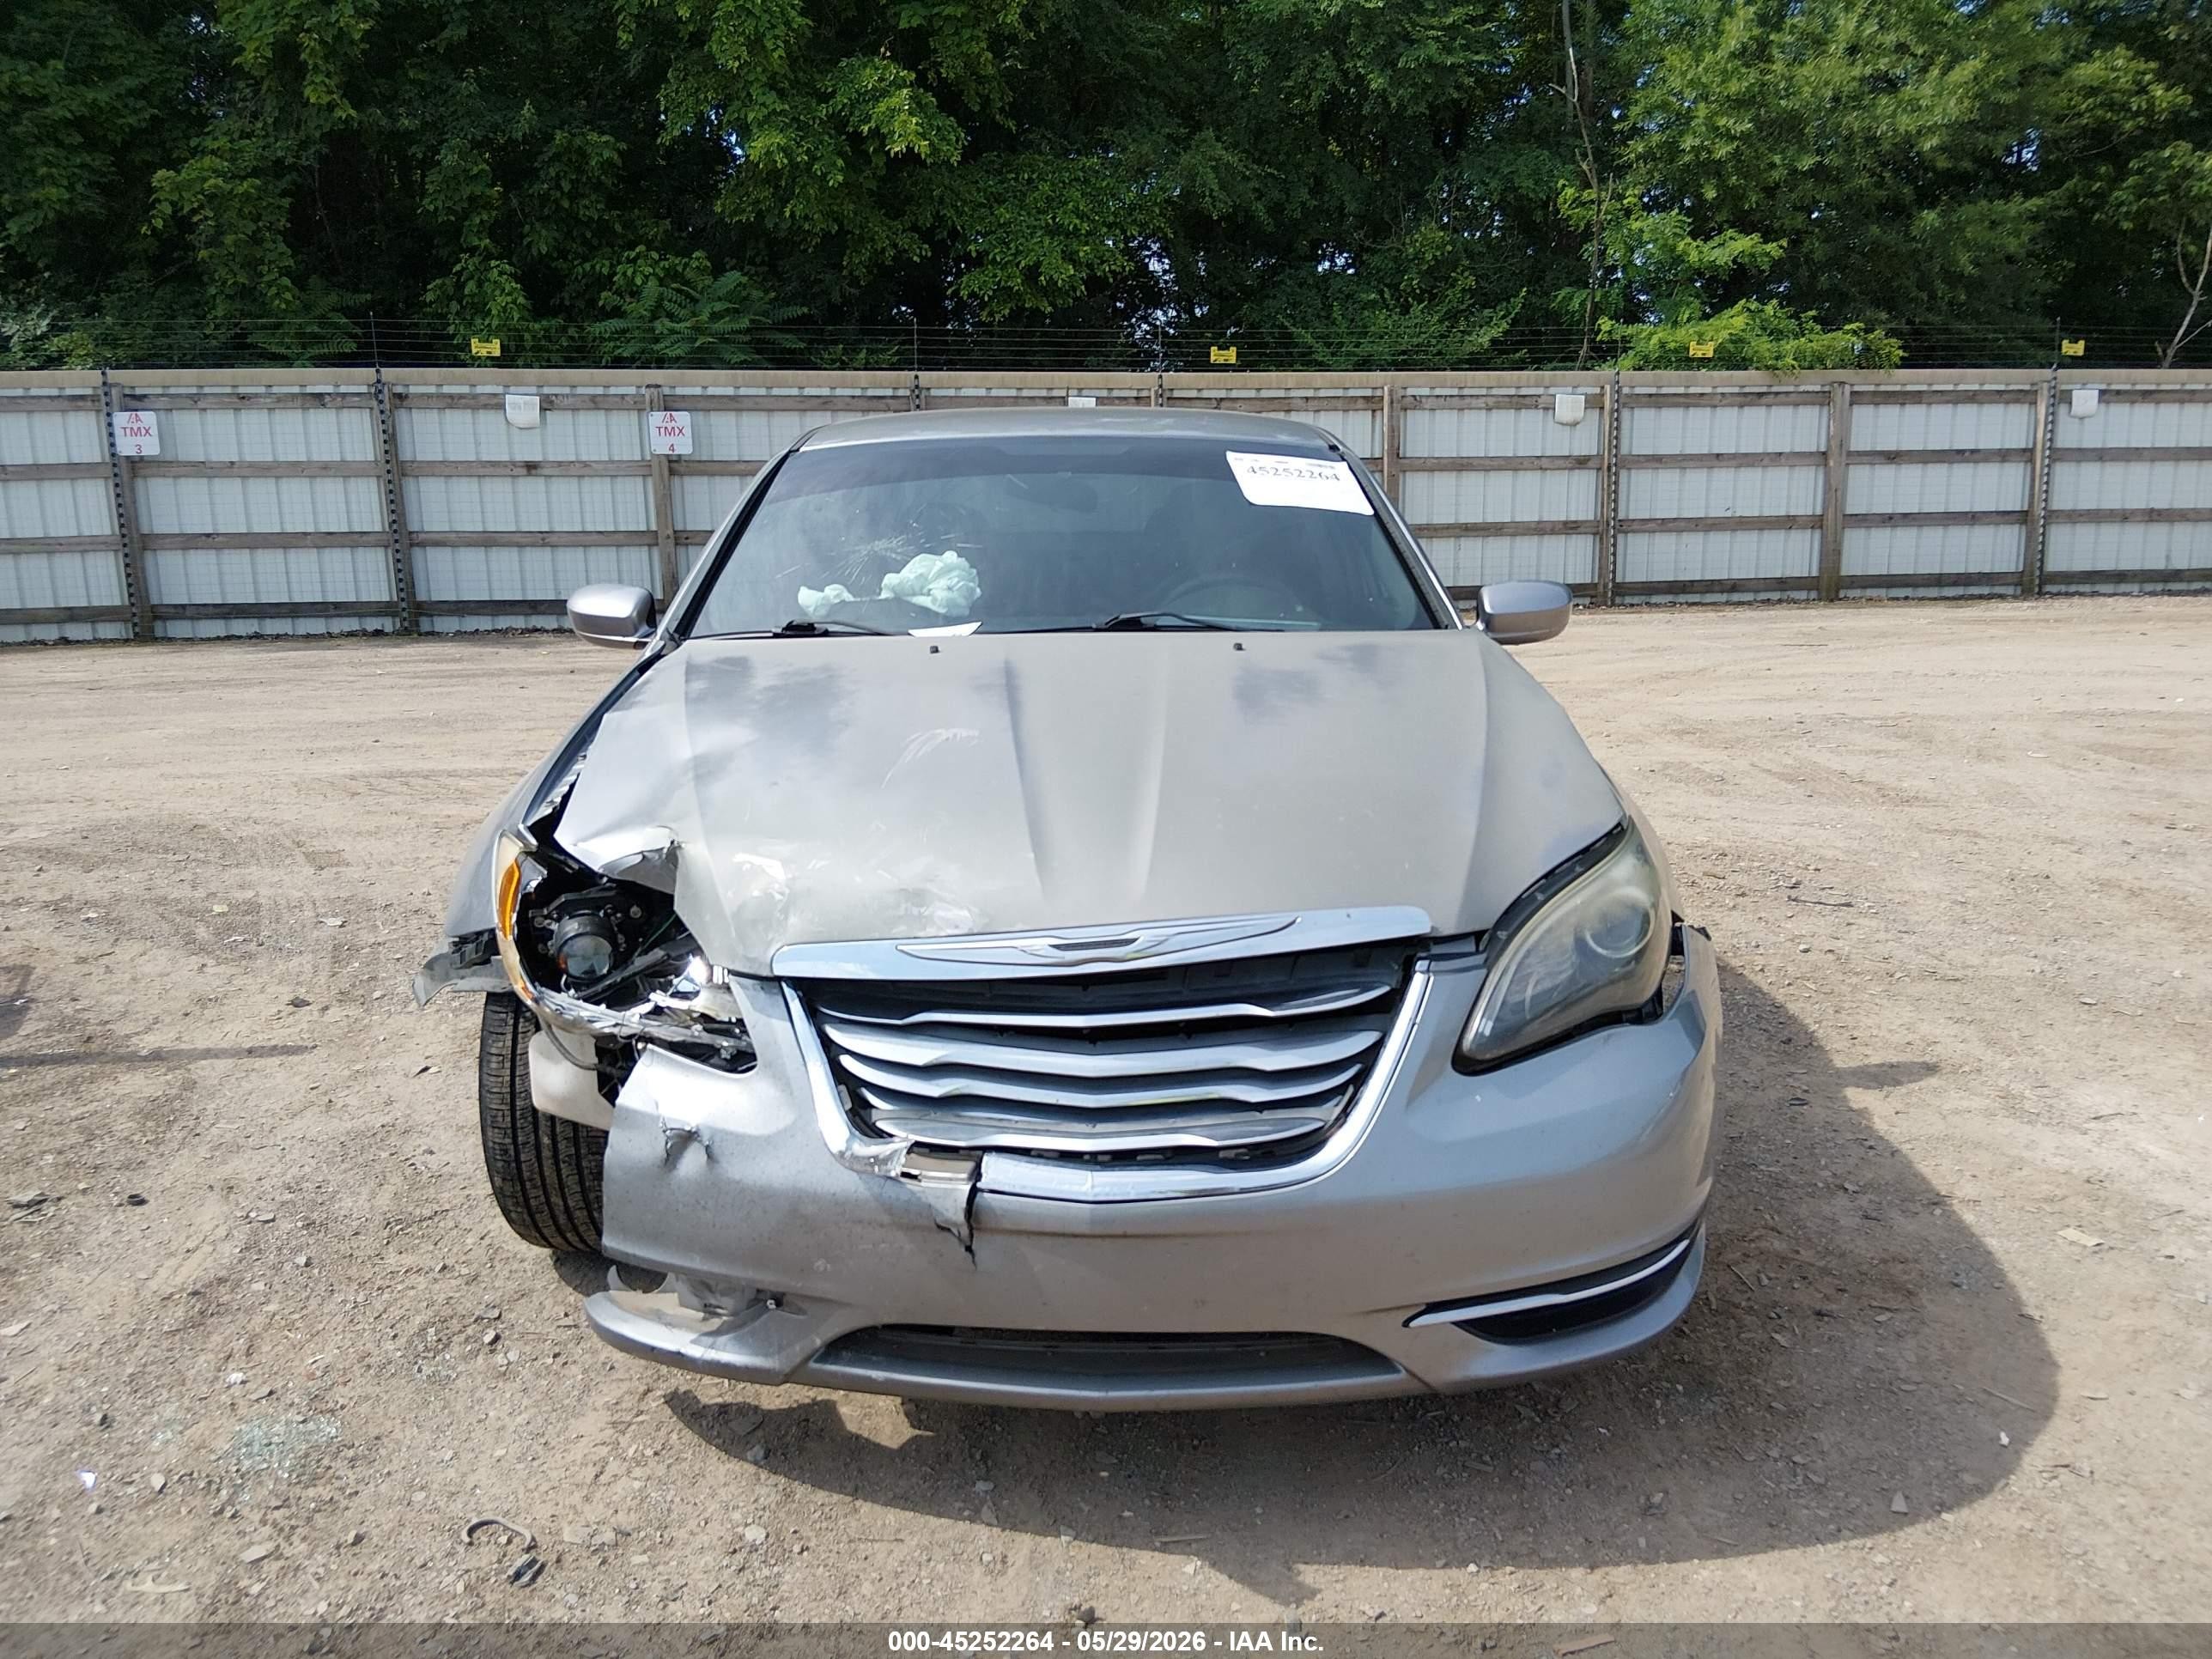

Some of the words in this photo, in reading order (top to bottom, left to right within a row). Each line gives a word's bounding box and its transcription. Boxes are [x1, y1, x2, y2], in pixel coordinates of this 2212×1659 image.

[120, 426, 153, 438] TMX
[655, 426, 685, 437] TMX
[135, 444, 143, 455] 3
[668, 443, 676, 453] 4
[1247, 465, 1340, 482] 45252264
